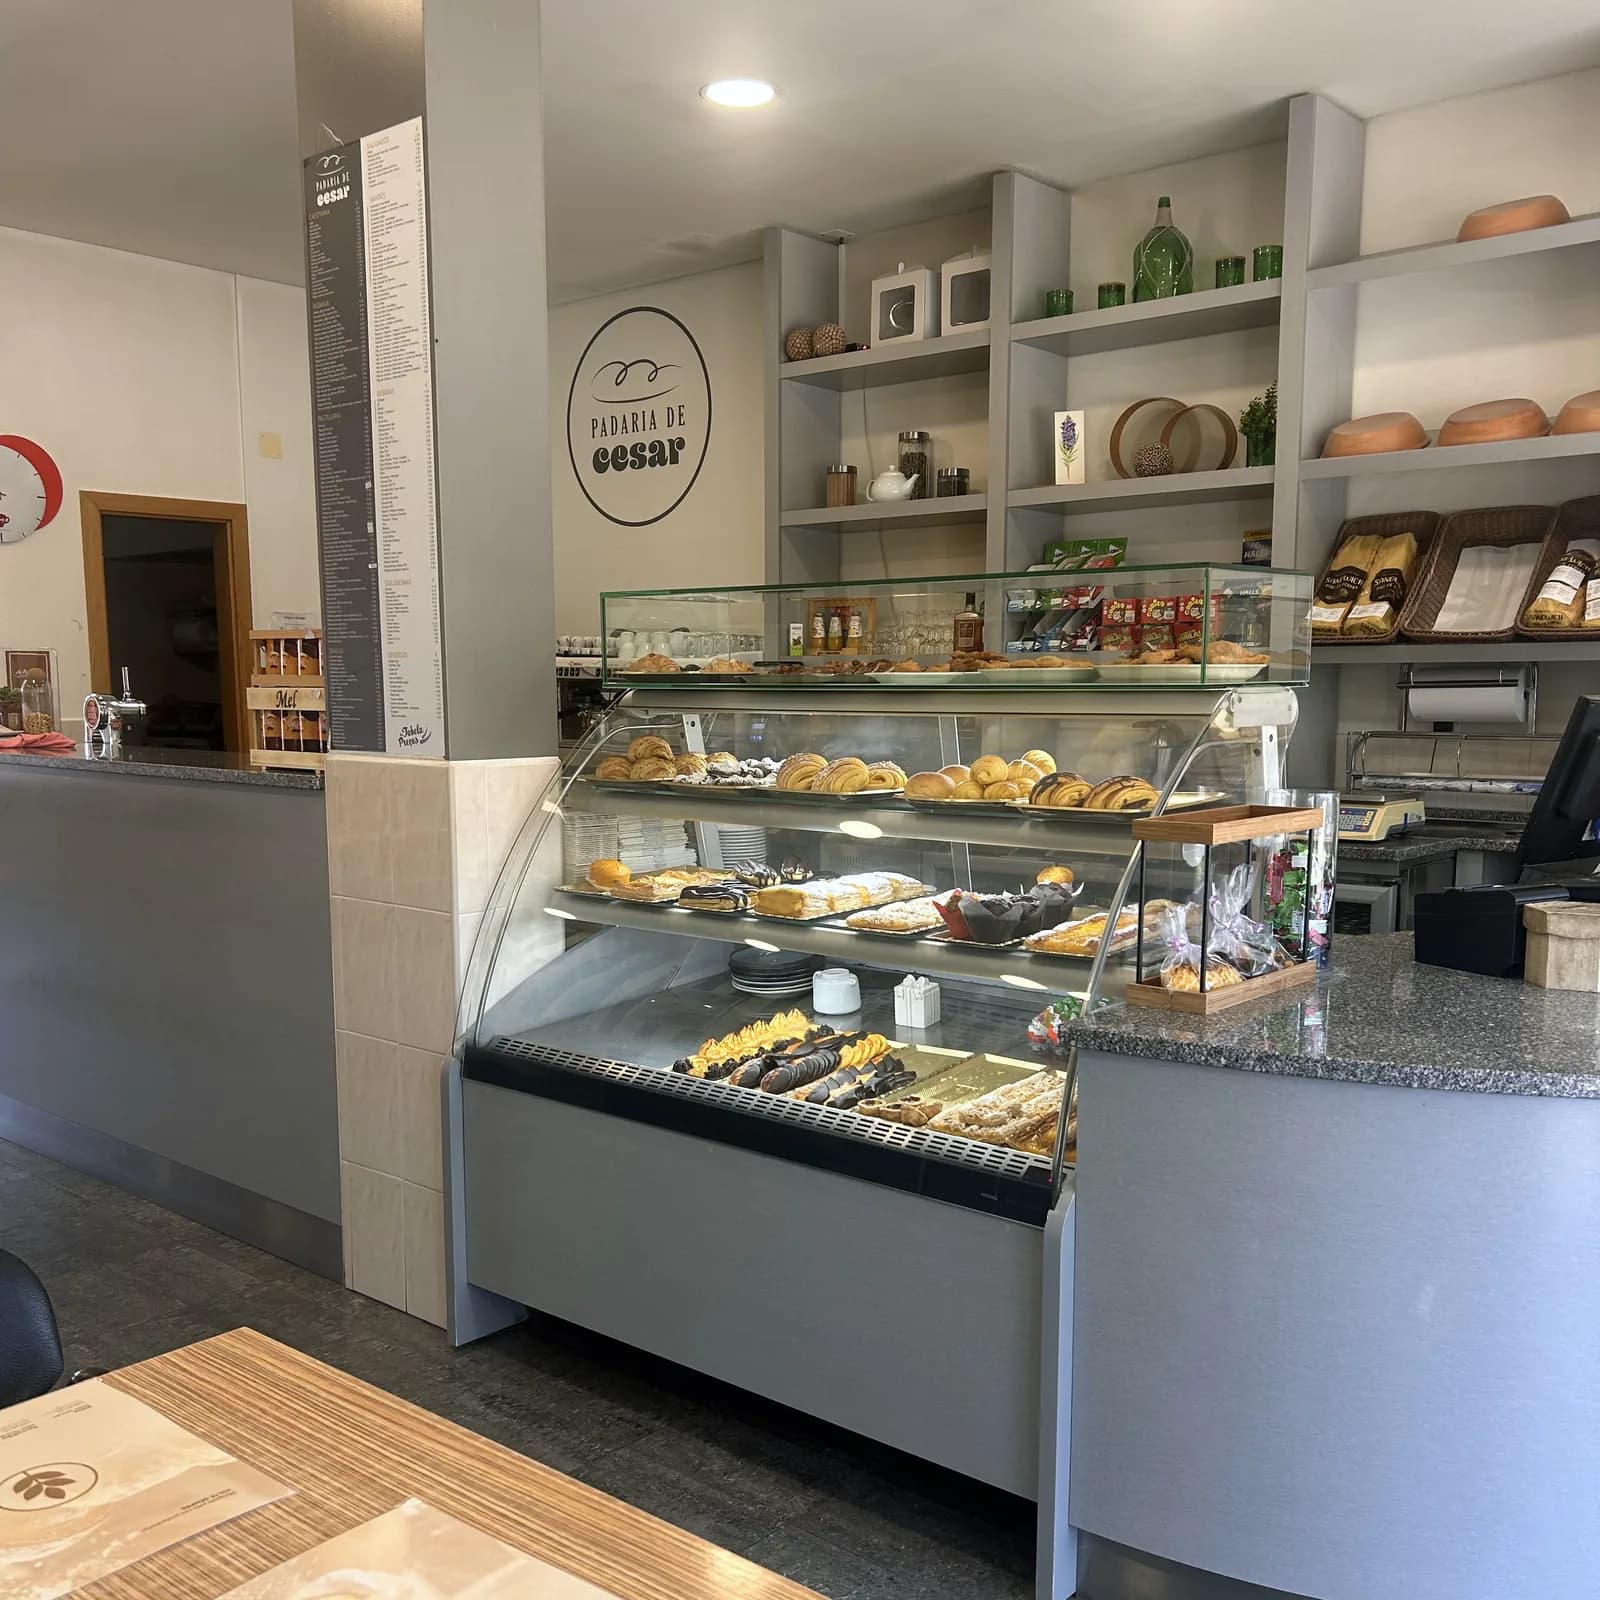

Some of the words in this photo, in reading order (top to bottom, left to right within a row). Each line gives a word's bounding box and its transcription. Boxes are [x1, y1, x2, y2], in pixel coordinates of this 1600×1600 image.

[315, 175, 340, 192] PADARIA
[341, 171, 350, 183] DE
[316, 185, 350, 207] cesar
[592, 409, 657, 438] PADARIA
[667, 404, 686, 428] DE
[592, 436, 686, 474] cesar
[276, 690, 298, 708] Mel
